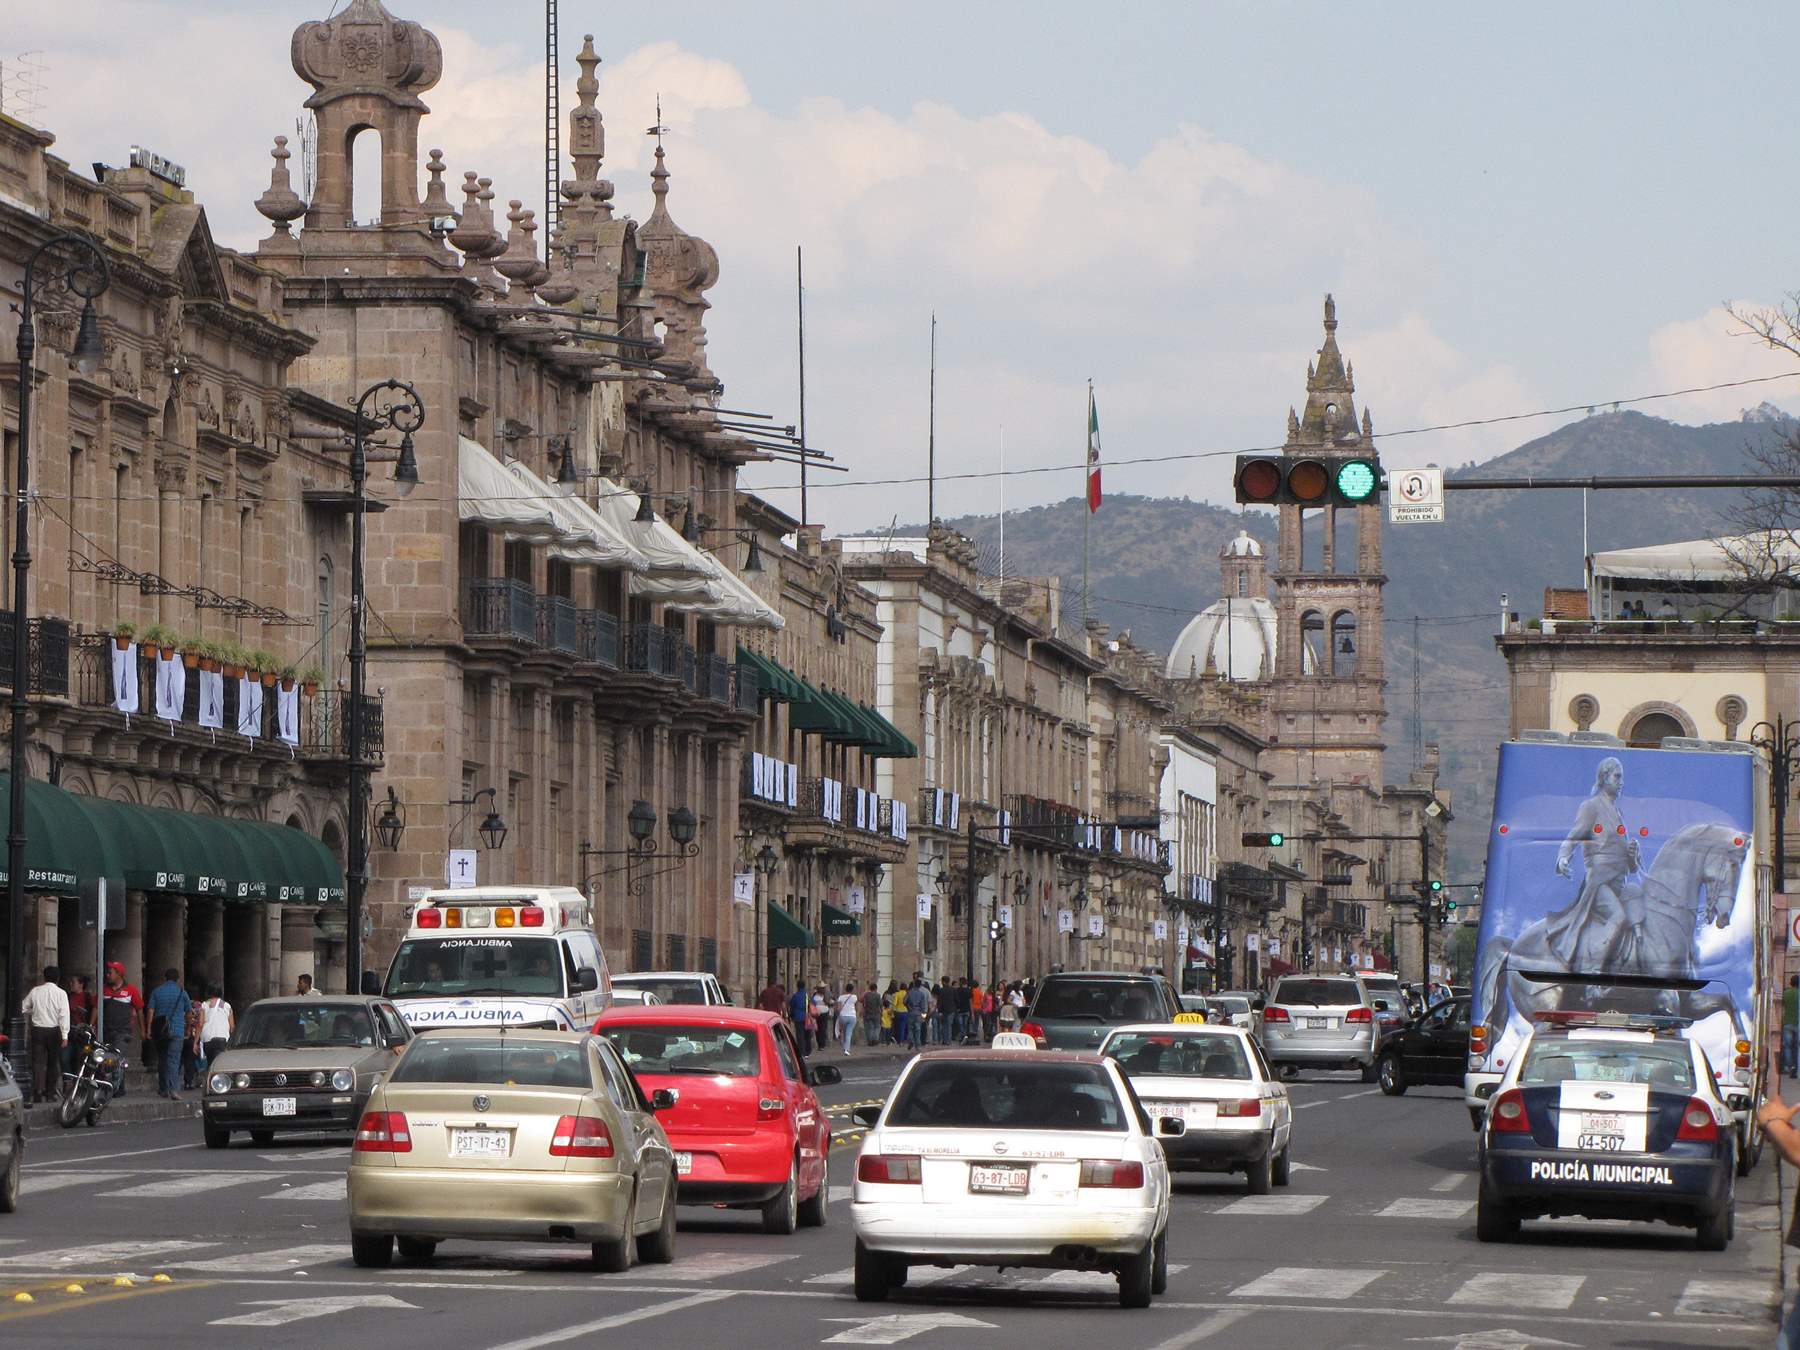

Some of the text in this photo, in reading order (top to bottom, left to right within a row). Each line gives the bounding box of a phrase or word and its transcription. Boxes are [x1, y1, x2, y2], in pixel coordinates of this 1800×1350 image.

[1179, 1014, 1200, 1023] TAXI
[999, 1036, 1029, 1046] TAXI
[1590, 1119, 1618, 1129] 04-507
[457, 1136, 506, 1149] PST-17-43
[1577, 1134, 1626, 1151] 04-507
[973, 1172, 1027, 1185] 63-87-LDB
[1531, 1160, 1673, 1185] POLICÍA MUNICIPAL
